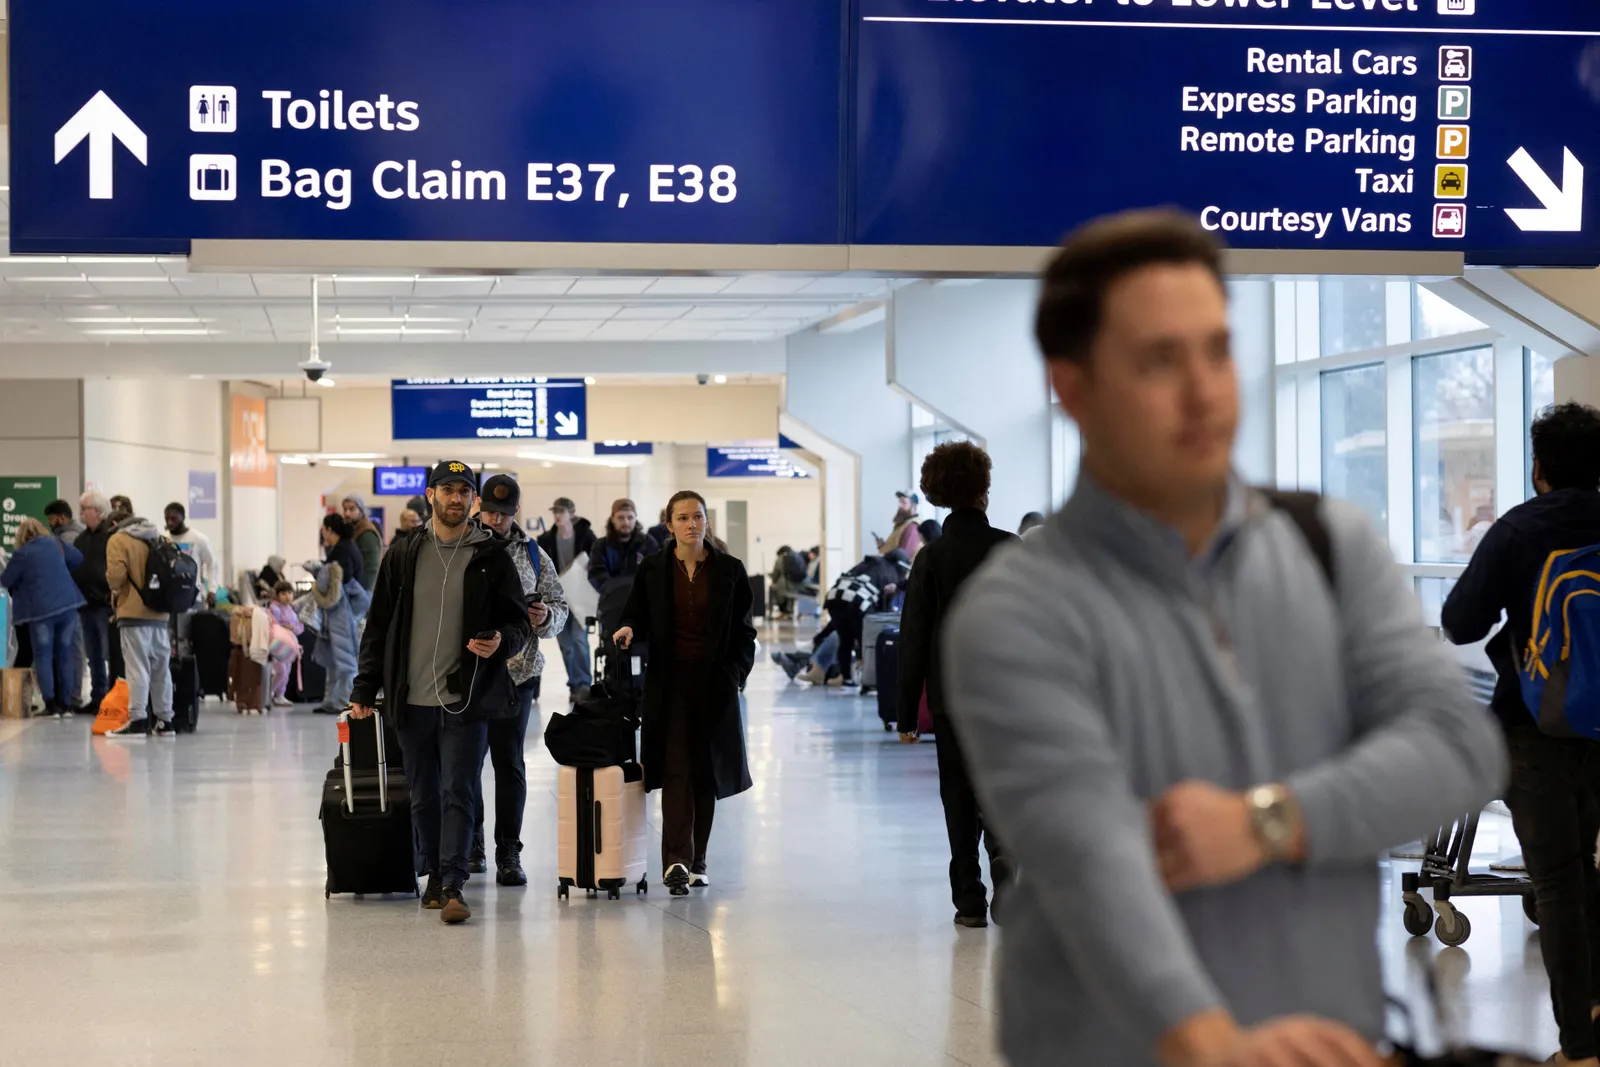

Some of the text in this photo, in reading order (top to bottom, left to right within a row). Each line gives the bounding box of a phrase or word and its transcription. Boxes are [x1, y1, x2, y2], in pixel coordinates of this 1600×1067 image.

[1247, 47, 1418, 76] Rental Cars
[261, 89, 420, 132] Toilets
[1182, 86, 1296, 119] Express
[1306, 88, 1417, 121] Parking
[1180, 125, 1295, 153] Remote
[1305, 127, 1416, 161] Parking
[261, 158, 738, 210] Bag Claim E37, E38
[1354, 167, 1414, 194] Taxi
[1200, 205, 1412, 239] Courtesy Vans
[397, 473, 425, 488] E37
